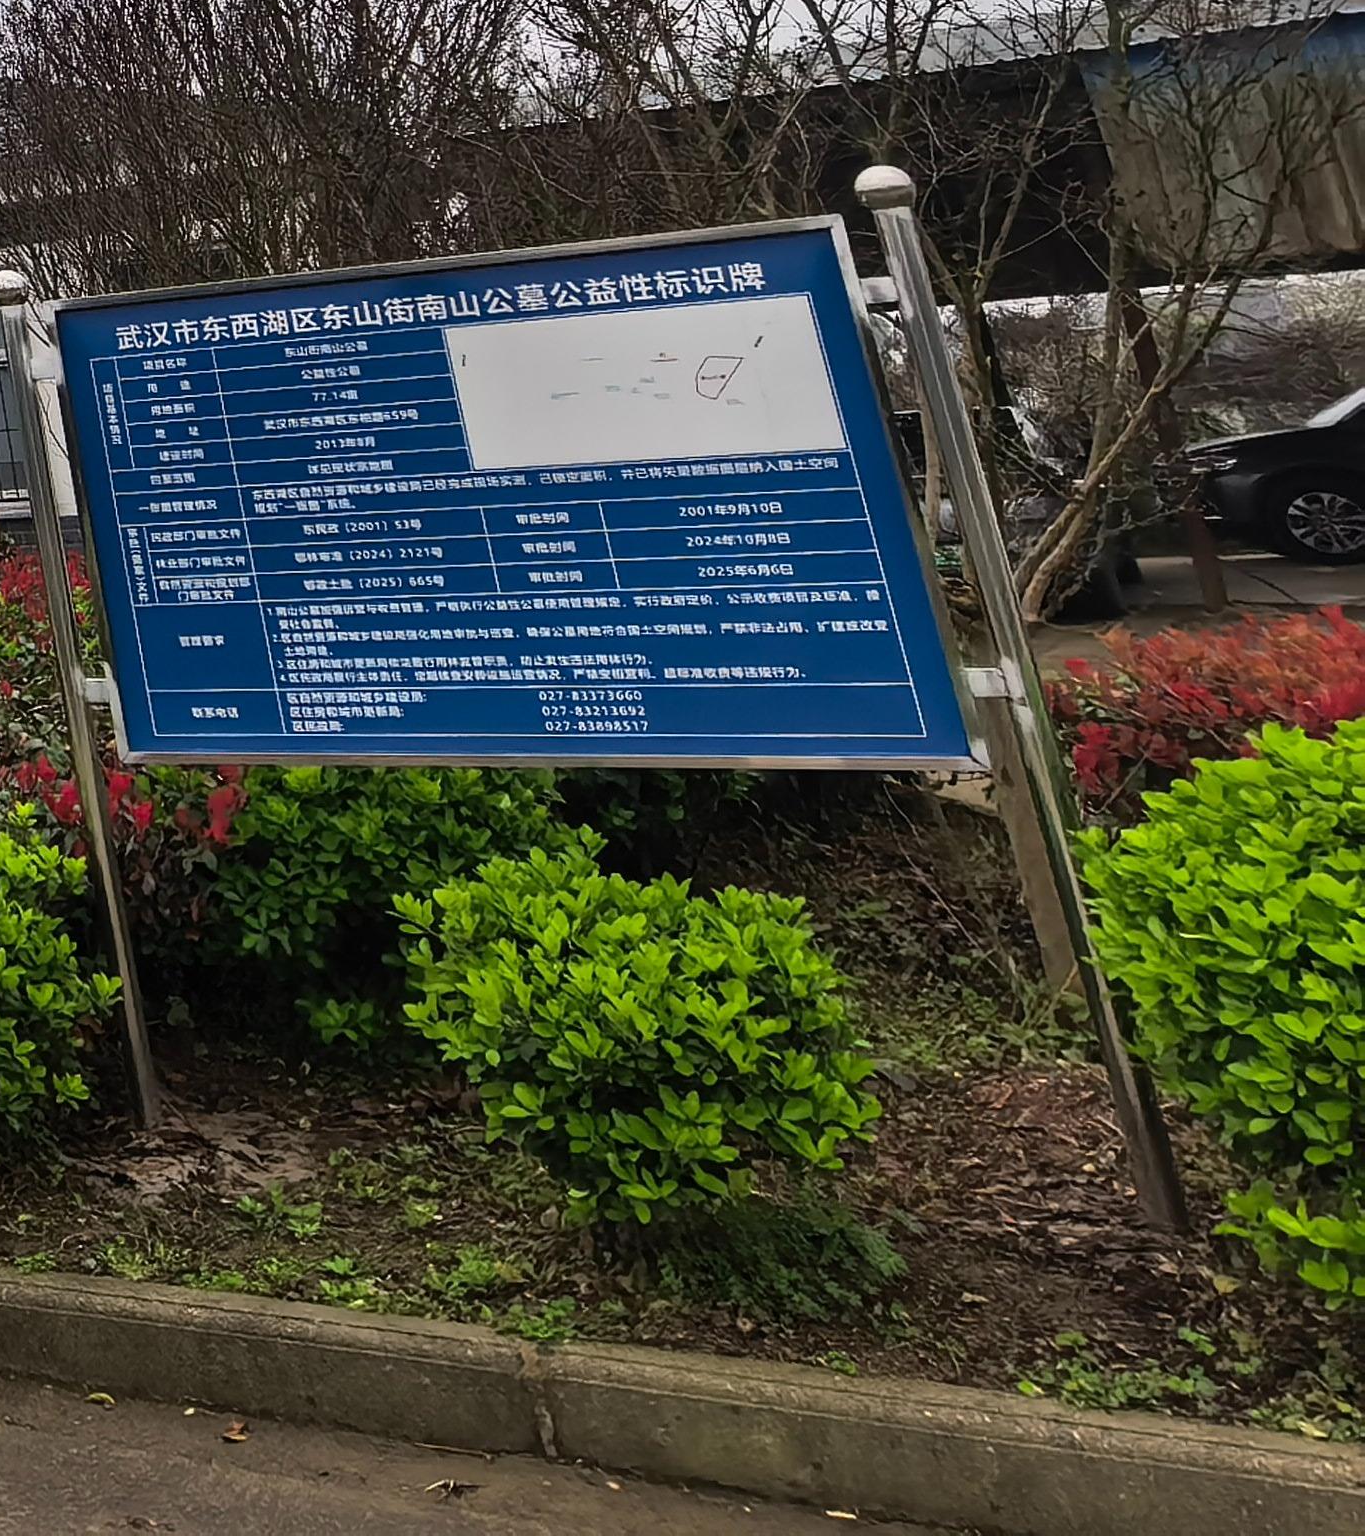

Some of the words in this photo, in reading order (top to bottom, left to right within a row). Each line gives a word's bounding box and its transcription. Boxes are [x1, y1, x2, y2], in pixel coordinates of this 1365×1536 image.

[115, 263, 767, 350] 武汉市东西湖区东山街南山公墓公益性标识牌
[679, 501, 783, 517] 2001年9月10日
[685, 532, 791, 547] 2024年10月8日
[697, 563, 794, 578] 2025年6月6日
